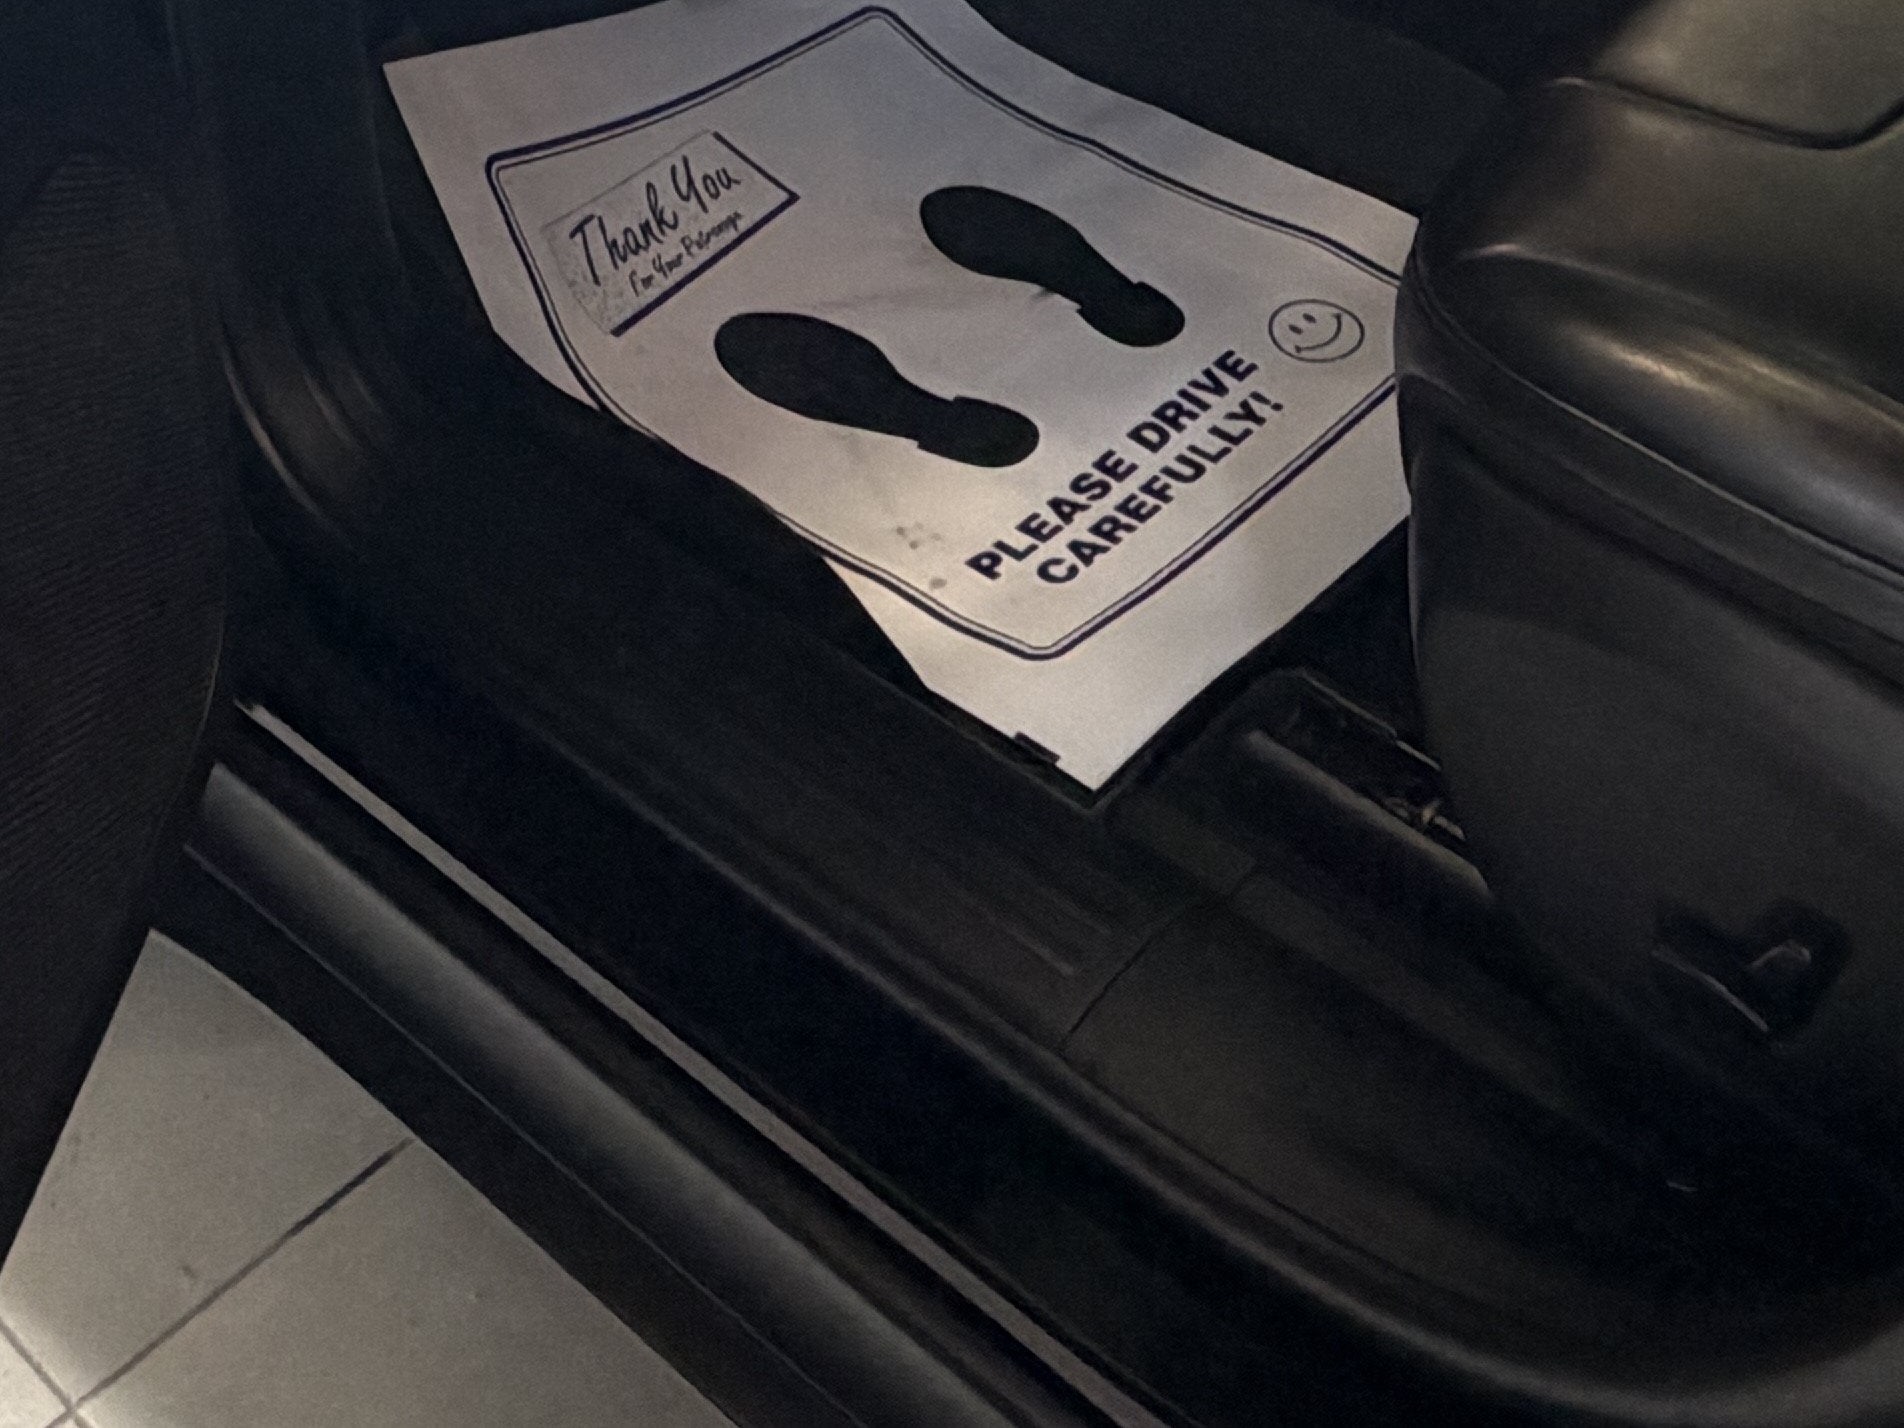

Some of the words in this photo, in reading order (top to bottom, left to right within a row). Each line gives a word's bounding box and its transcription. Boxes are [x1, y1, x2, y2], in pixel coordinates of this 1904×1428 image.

[569, 181, 679, 287] Thank
[670, 155, 742, 214] You
[965, 448, 1138, 581] PLEASE
[1126, 349, 1259, 453] DRIVE
[1036, 390, 1284, 584] CAREFULLY!
